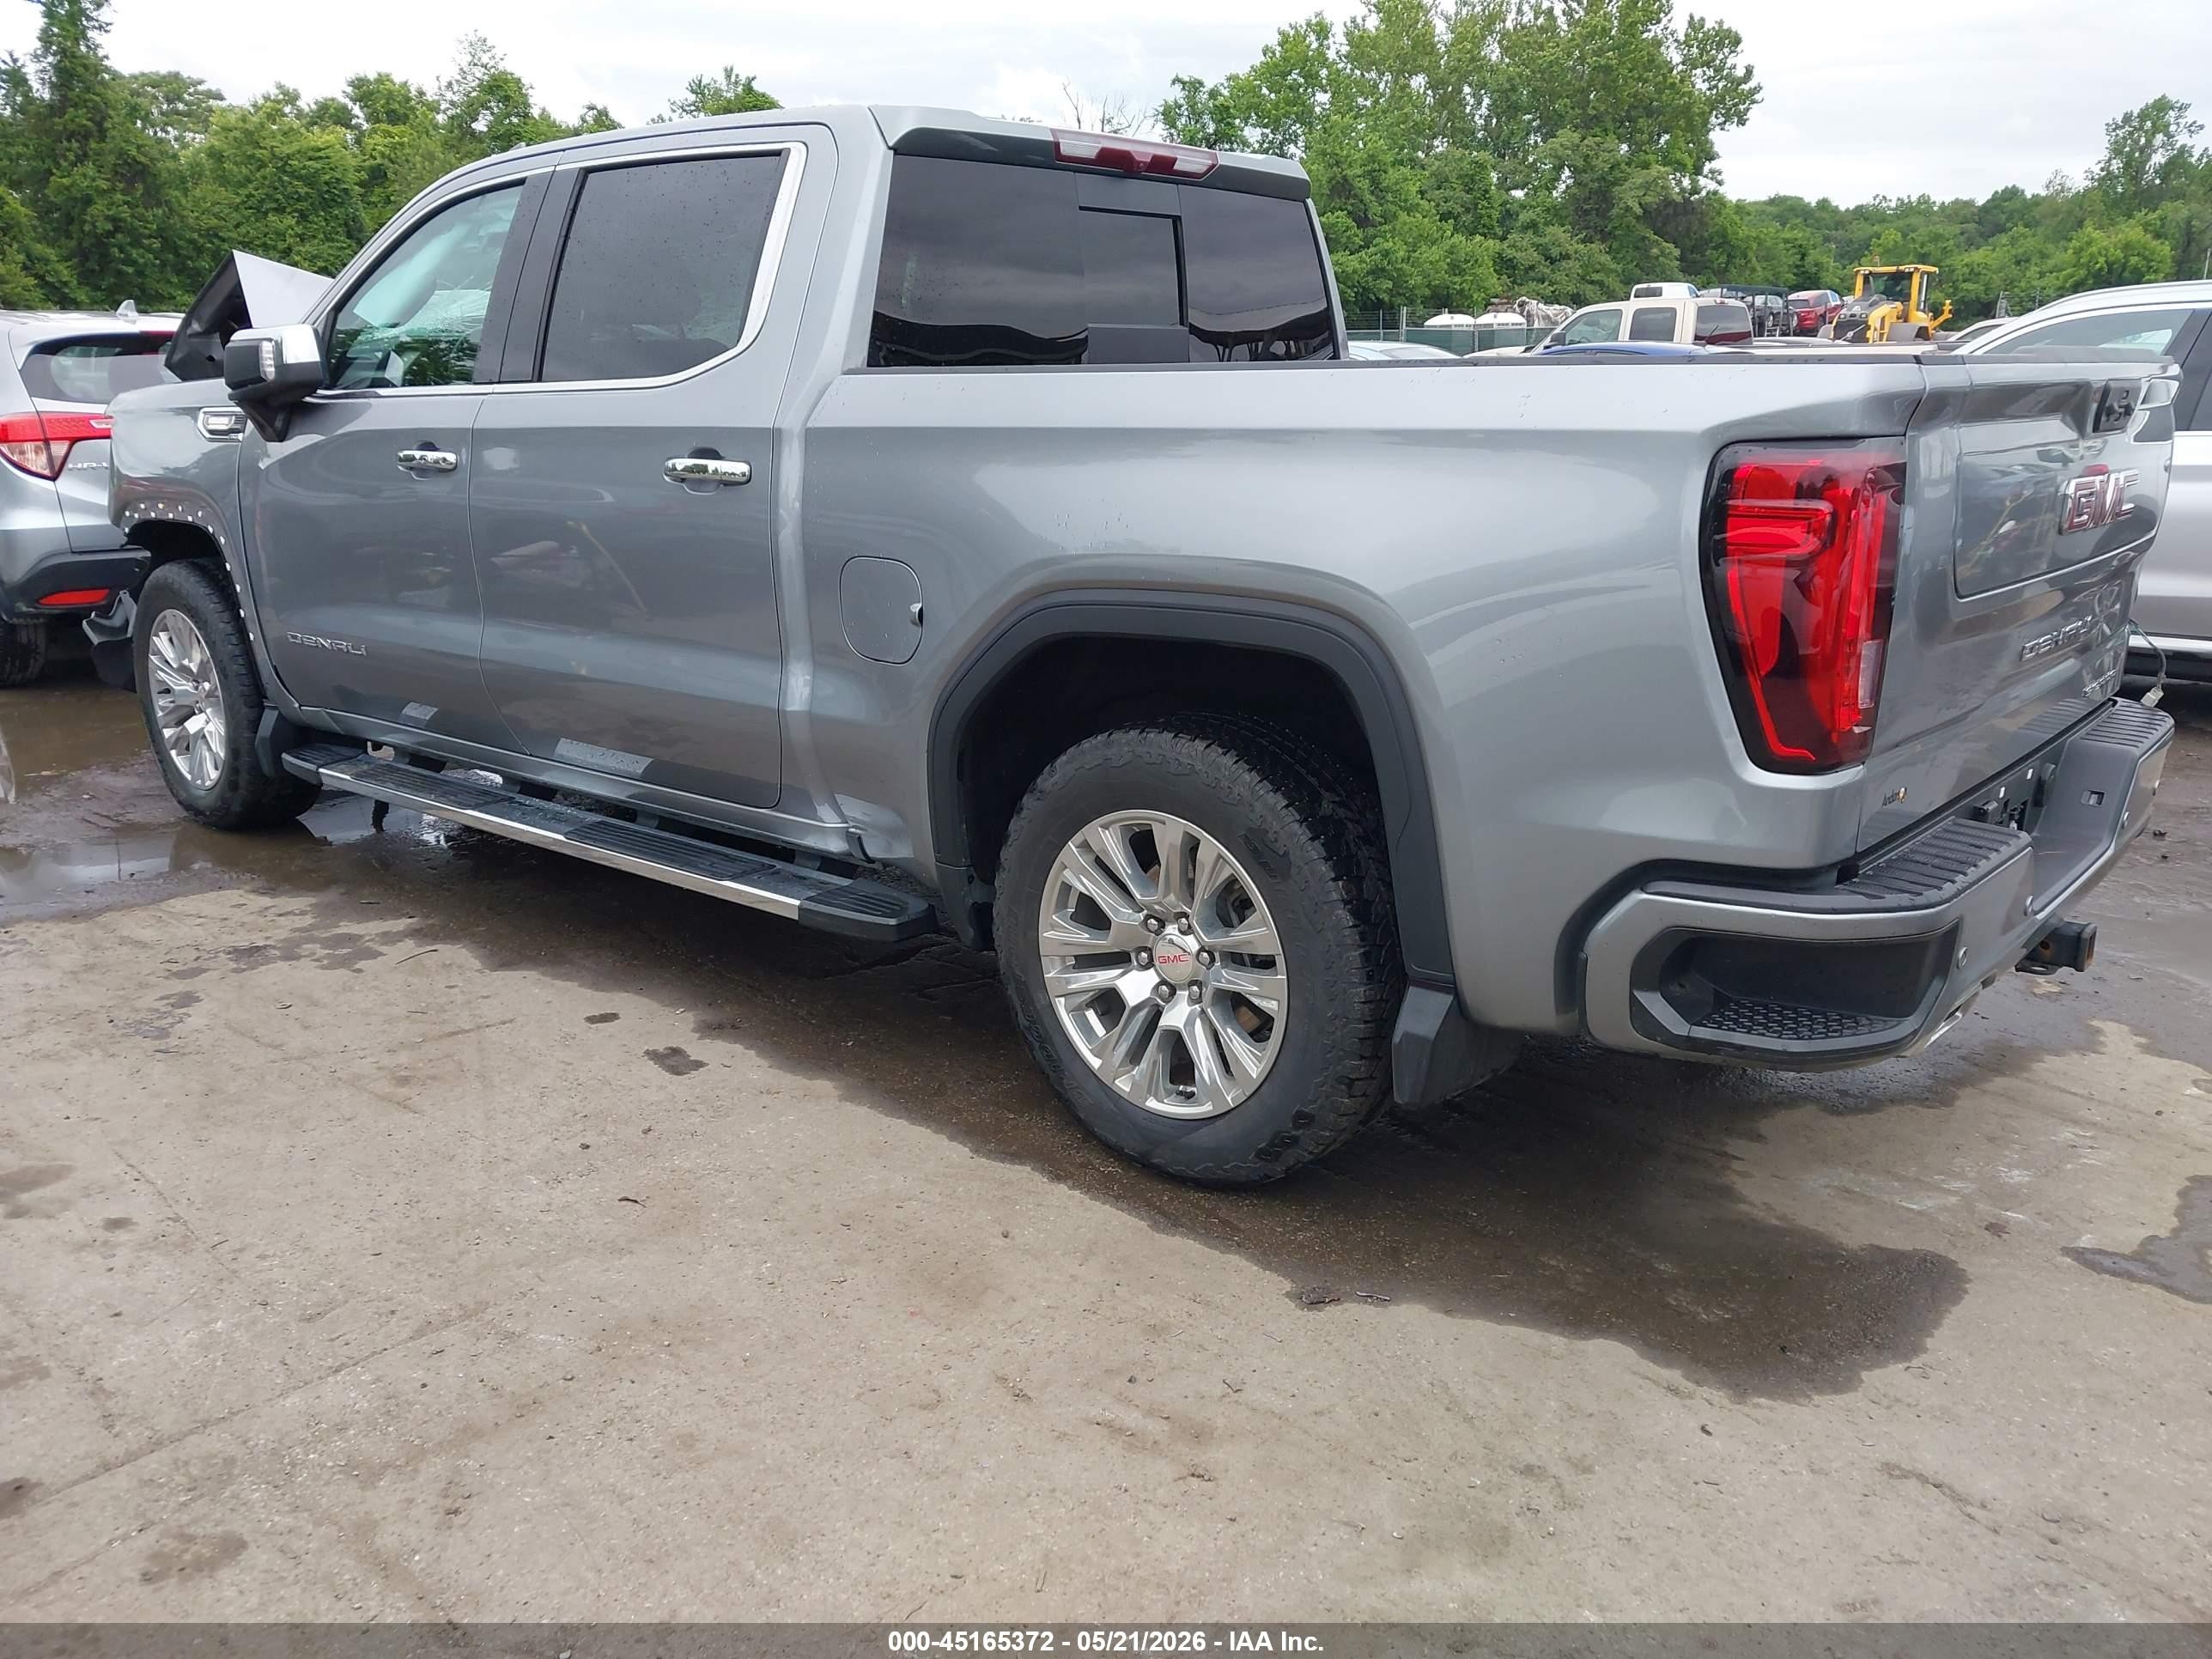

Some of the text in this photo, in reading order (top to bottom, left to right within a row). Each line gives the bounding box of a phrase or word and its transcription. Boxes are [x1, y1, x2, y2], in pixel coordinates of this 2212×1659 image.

[2067, 470, 2140, 532] GMC
[286, 631, 368, 656] DENALI
[1158, 953, 1189, 964] GMC
